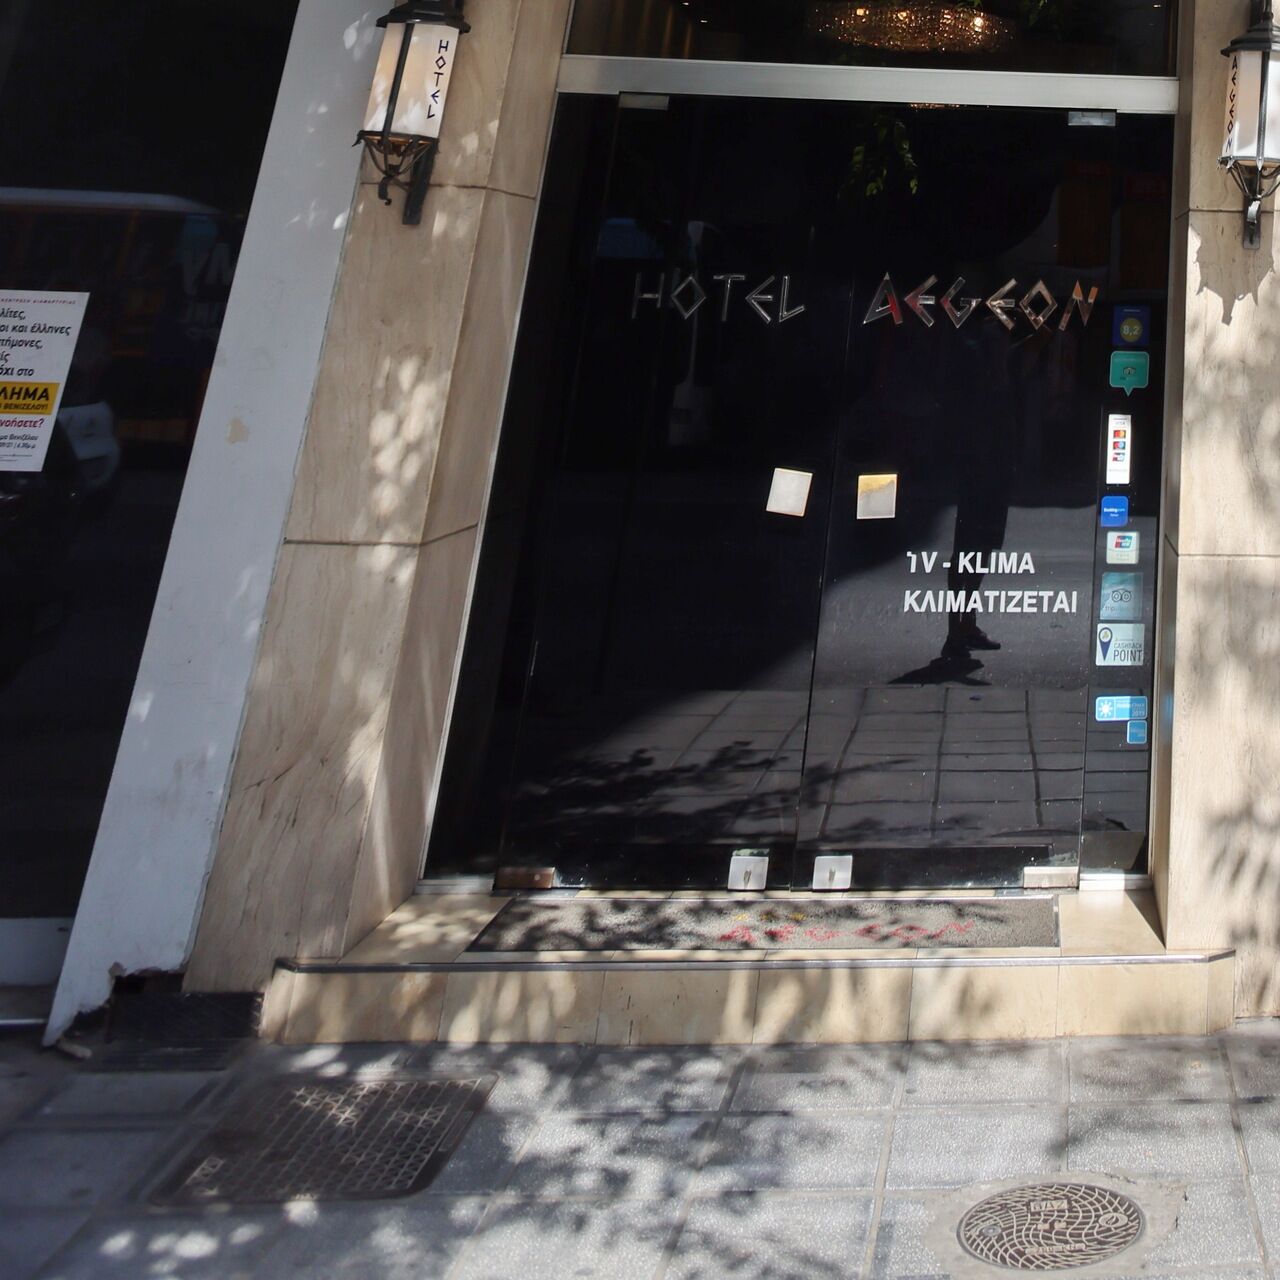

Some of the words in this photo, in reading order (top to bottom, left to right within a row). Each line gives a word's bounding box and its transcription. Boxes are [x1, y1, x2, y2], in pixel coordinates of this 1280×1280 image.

[426, 39, 449, 120] HOTEL
[632, 272, 805, 325] HOTEL
[862, 270, 1100, 332] AEGEON
[958, 551, 1036, 574] KLIMA
[1113, 649, 1143, 662] POINT
